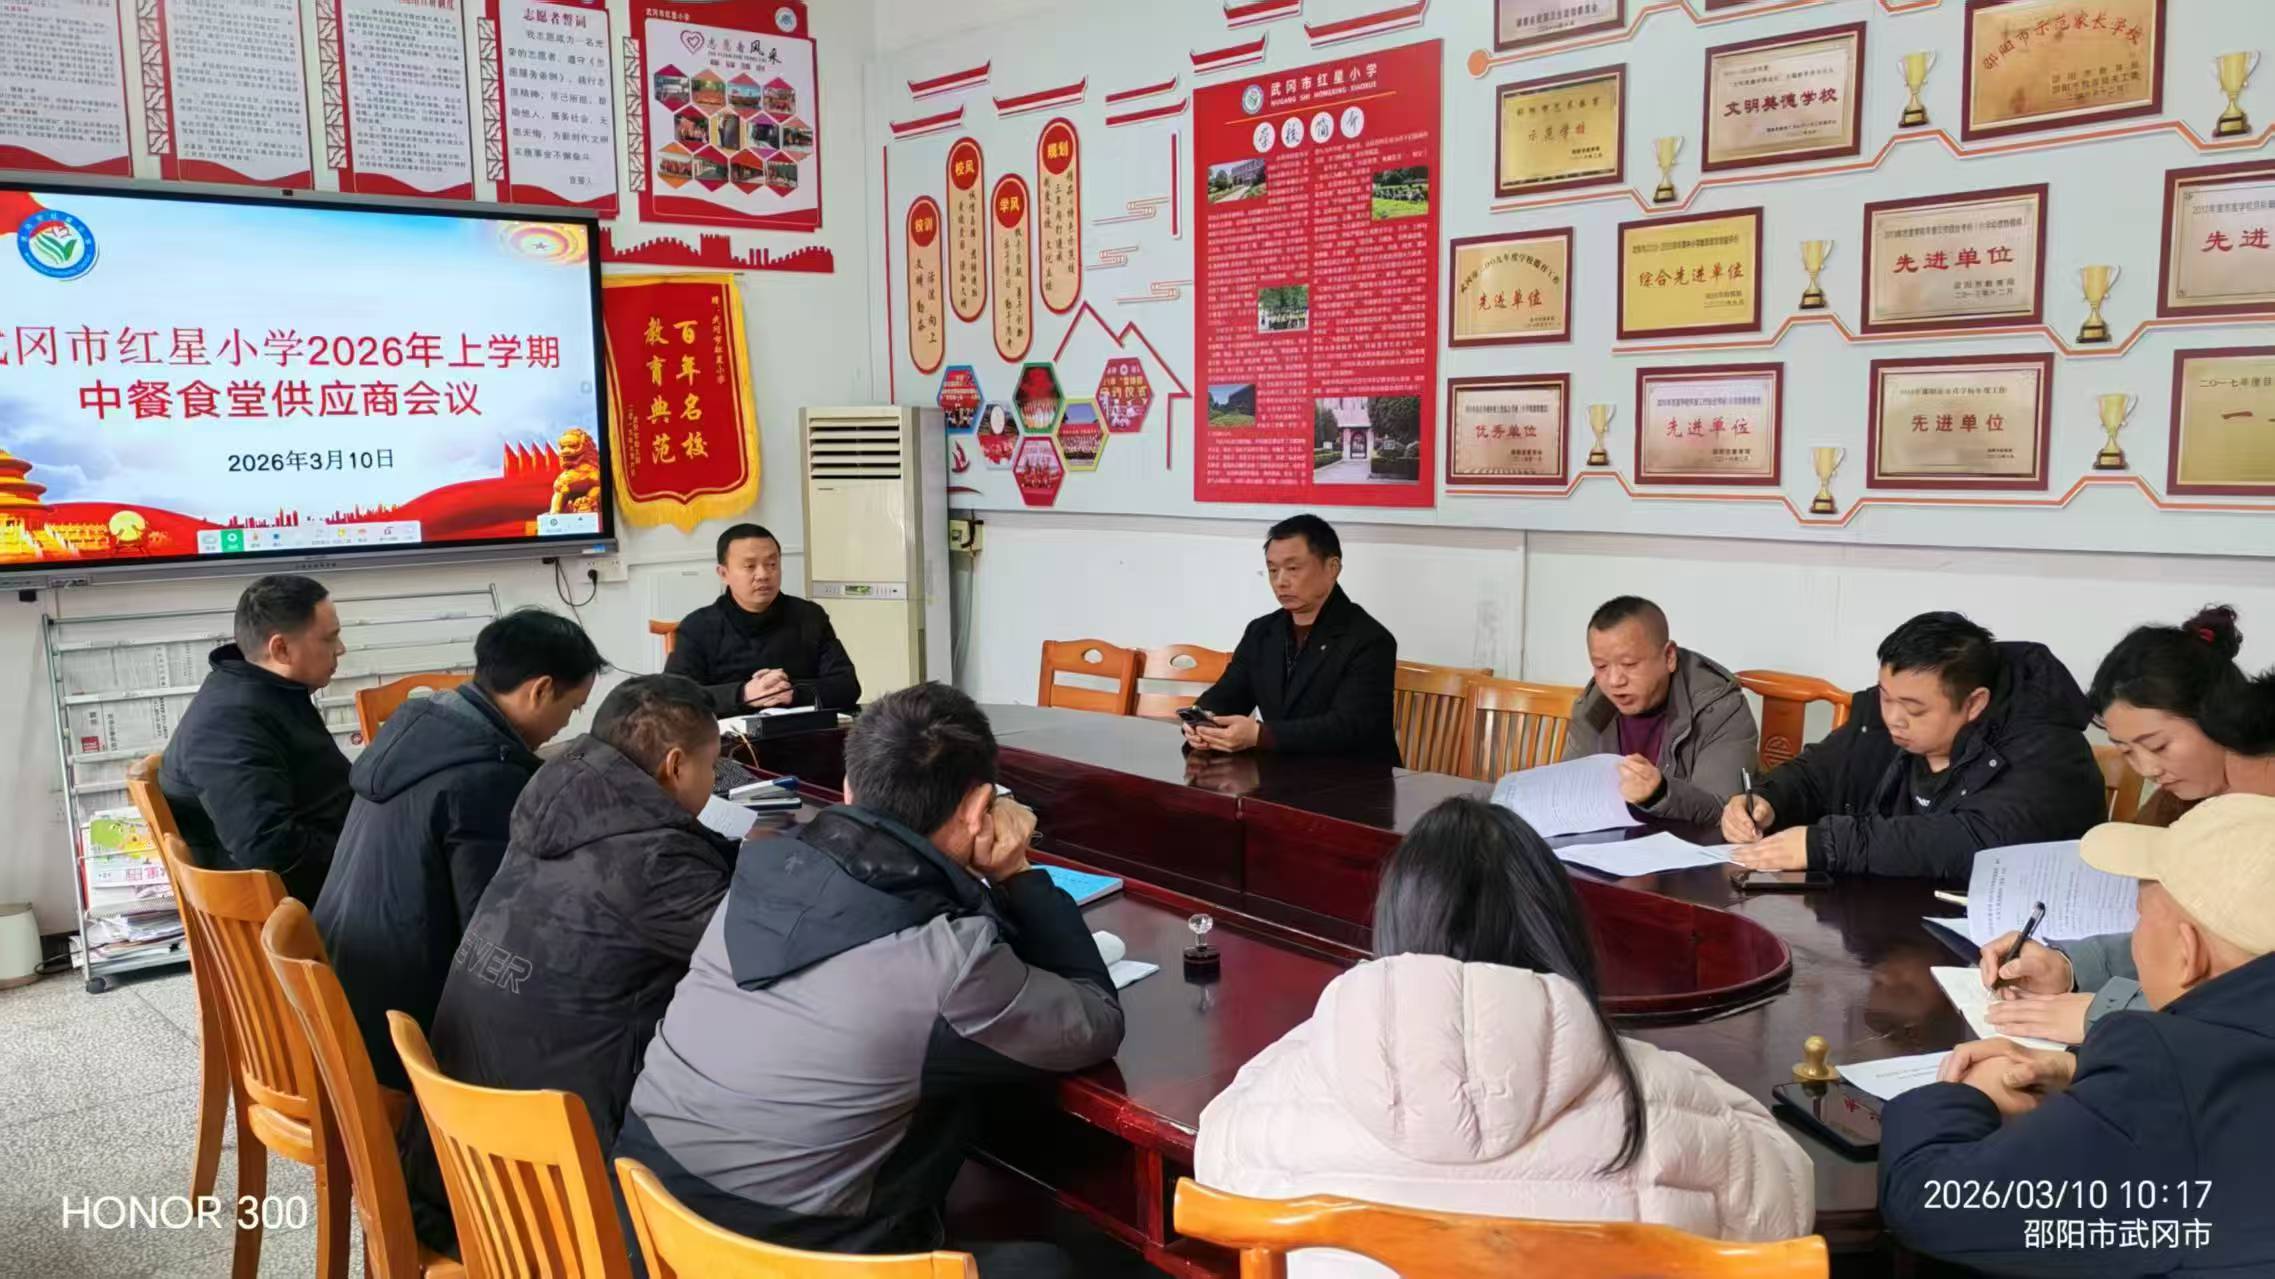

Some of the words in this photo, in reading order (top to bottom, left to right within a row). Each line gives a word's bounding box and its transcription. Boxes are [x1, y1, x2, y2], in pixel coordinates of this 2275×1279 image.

[523, 8, 587, 29] 志愿者誓词
[1982, 9, 2143, 71] 邵阳市示范家长学校
[1270, 62, 1378, 97] 武冈市红星小学
[1047, 141, 1069, 159] 规划
[955, 159, 975, 176] 校风
[1000, 196, 1020, 213] 学风
[914, 216, 933, 233] 校训
[2201, 227, 2271, 252] 先进
[1893, 245, 2015, 274] 先进单位
[1639, 261, 1745, 288] 综合先进单位
[1478, 288, 1542, 311] 先进单位
[0, 324, 560, 369] 冈市红星小学2026年上学期
[79, 379, 482, 420] 中餐食堂供应商会议
[644, 316, 677, 465] 教育典范
[673, 319, 710, 459] 百年名校
[1474, 423, 1538, 440] 优秀单位
[1665, 416, 1752, 441] 先进单位
[1912, 413, 2005, 433] 先进单位
[228, 449, 394, 472] 2026年3月10日
